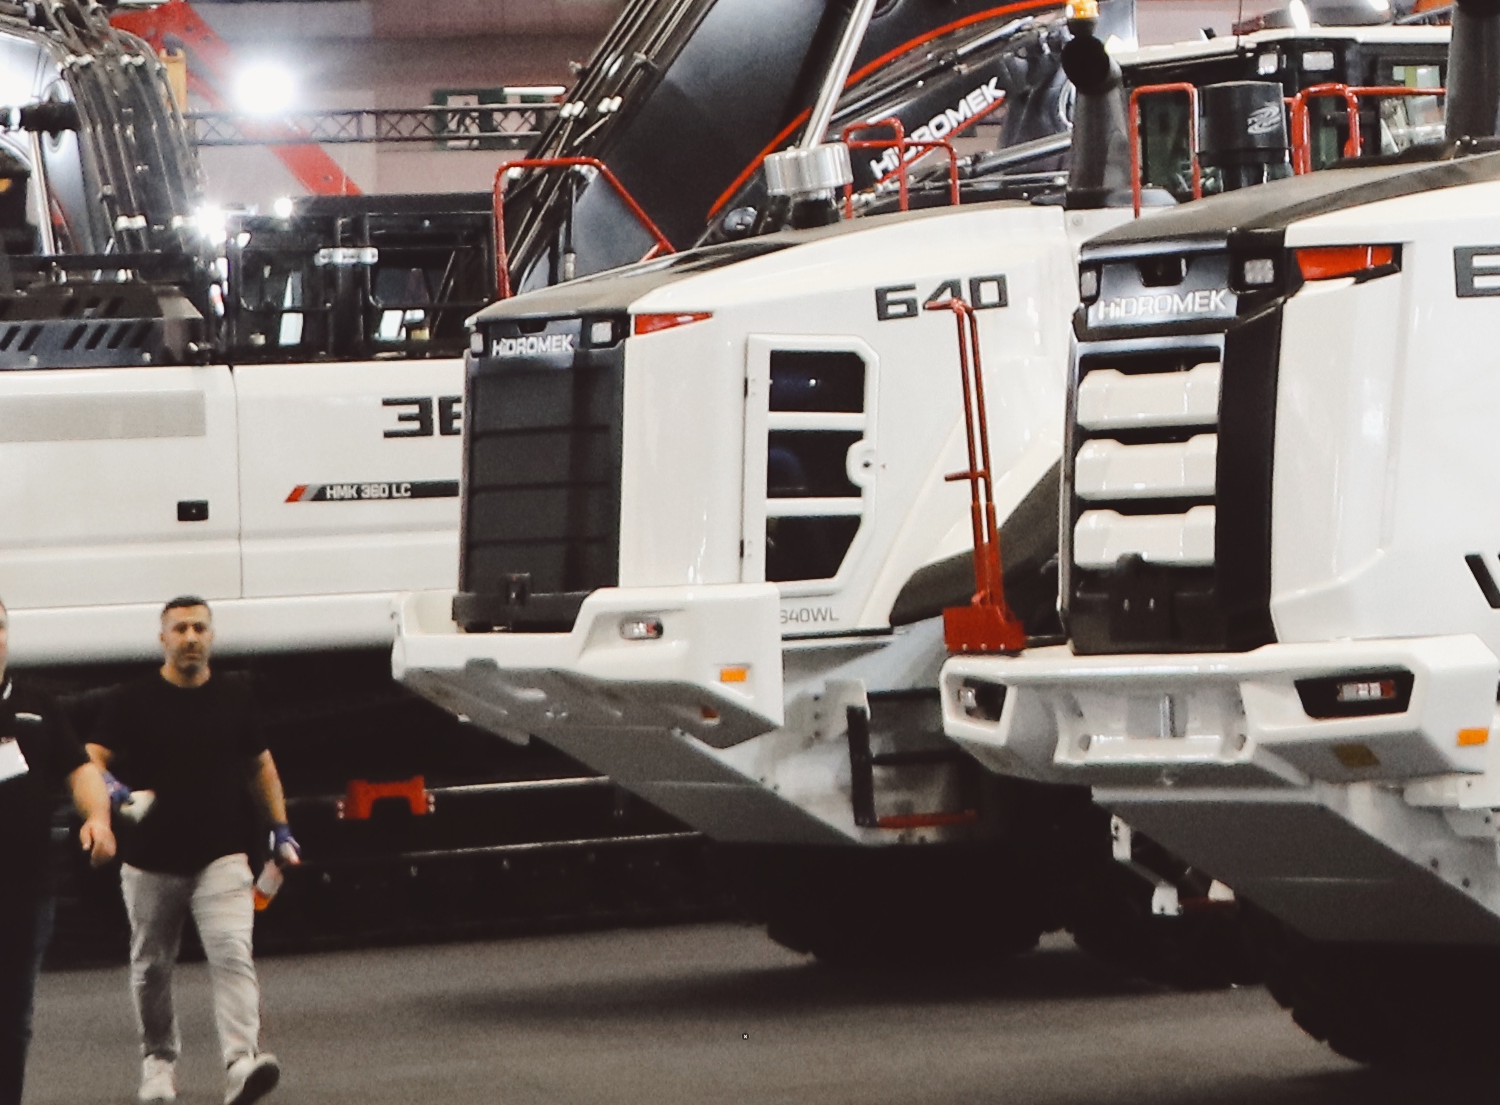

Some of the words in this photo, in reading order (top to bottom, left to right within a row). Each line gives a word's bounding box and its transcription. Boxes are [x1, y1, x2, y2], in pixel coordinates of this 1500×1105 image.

[875, 274, 1008, 322] 640
[326, 484, 358, 499] HMK
[361, 483, 389, 498] 360
[392, 482, 412, 497] LC
